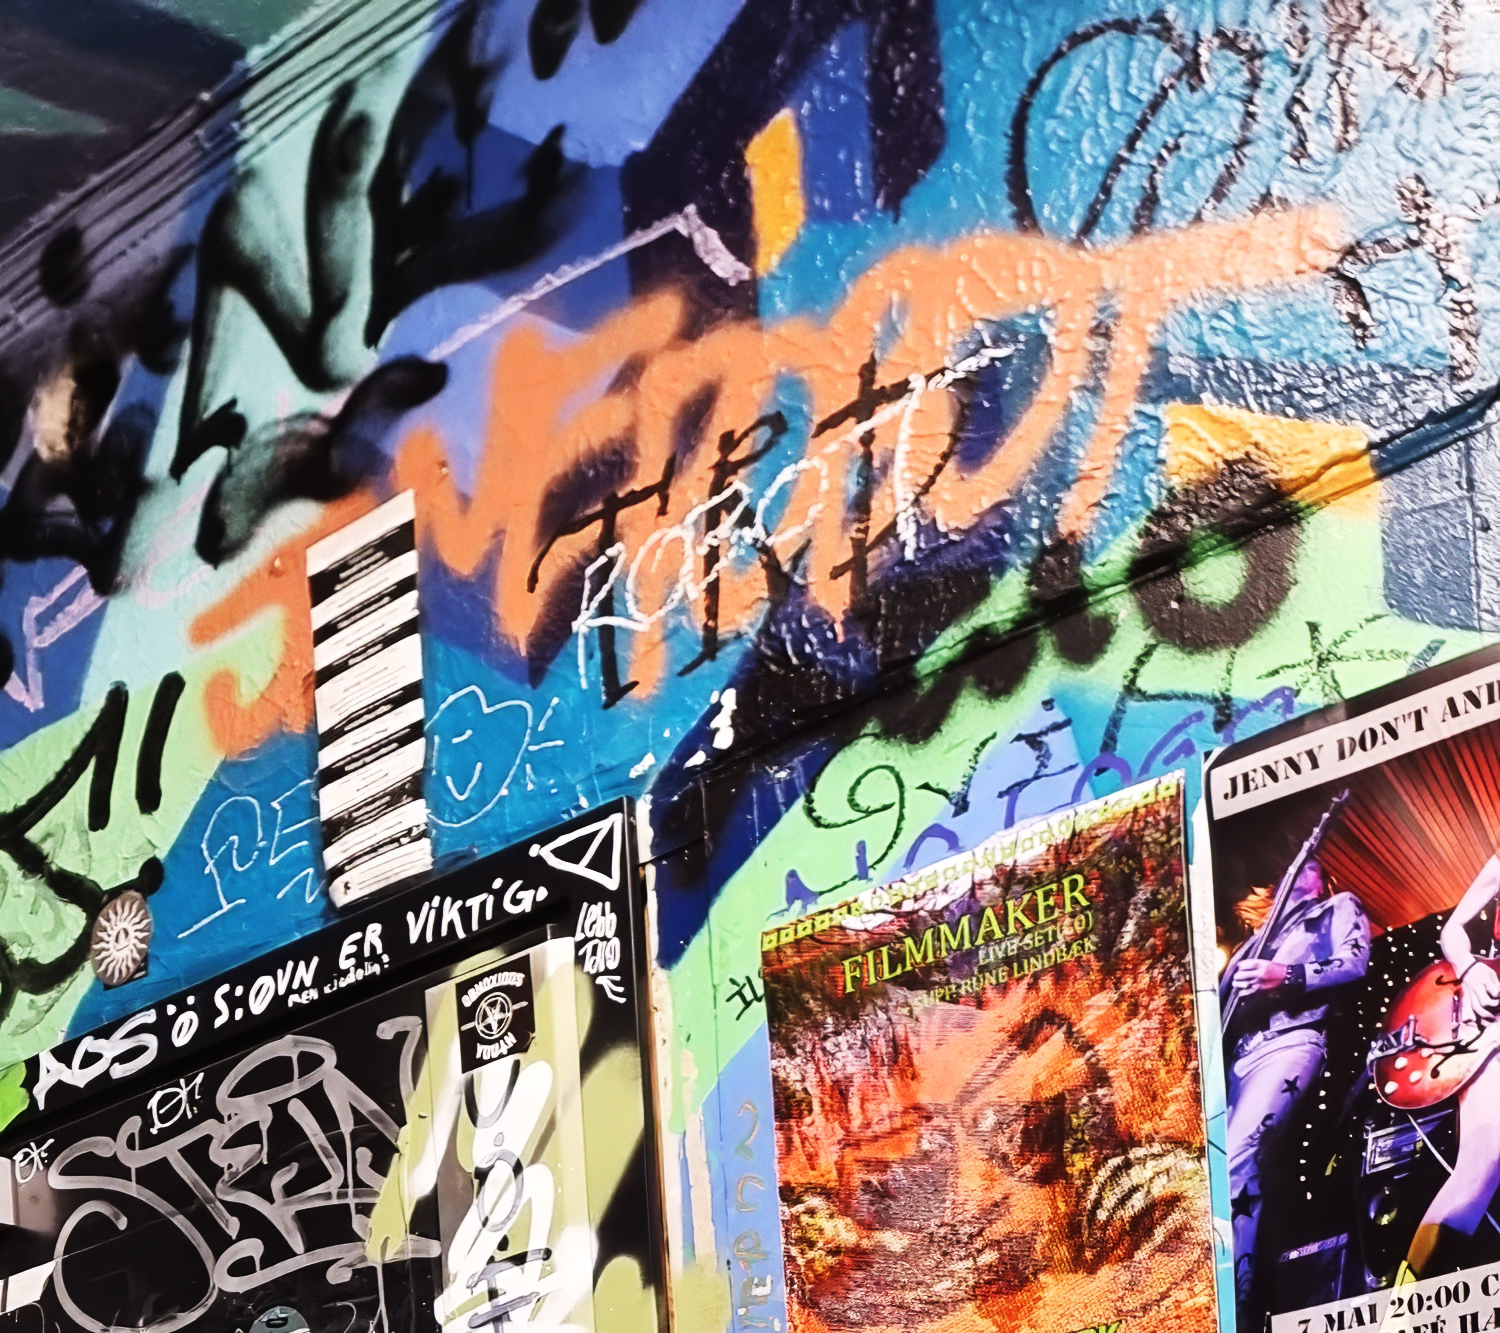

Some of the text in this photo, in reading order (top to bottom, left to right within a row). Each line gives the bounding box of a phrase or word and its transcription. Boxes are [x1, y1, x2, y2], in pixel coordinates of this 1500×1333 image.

[1224, 745, 1323, 800] JENNY
[1337, 705, 1428, 762] DON'T
[338, 923, 382, 969] ER
[842, 873, 1091, 994] FILMMAKER
[1390, 1281, 1470, 1318] 20:00
